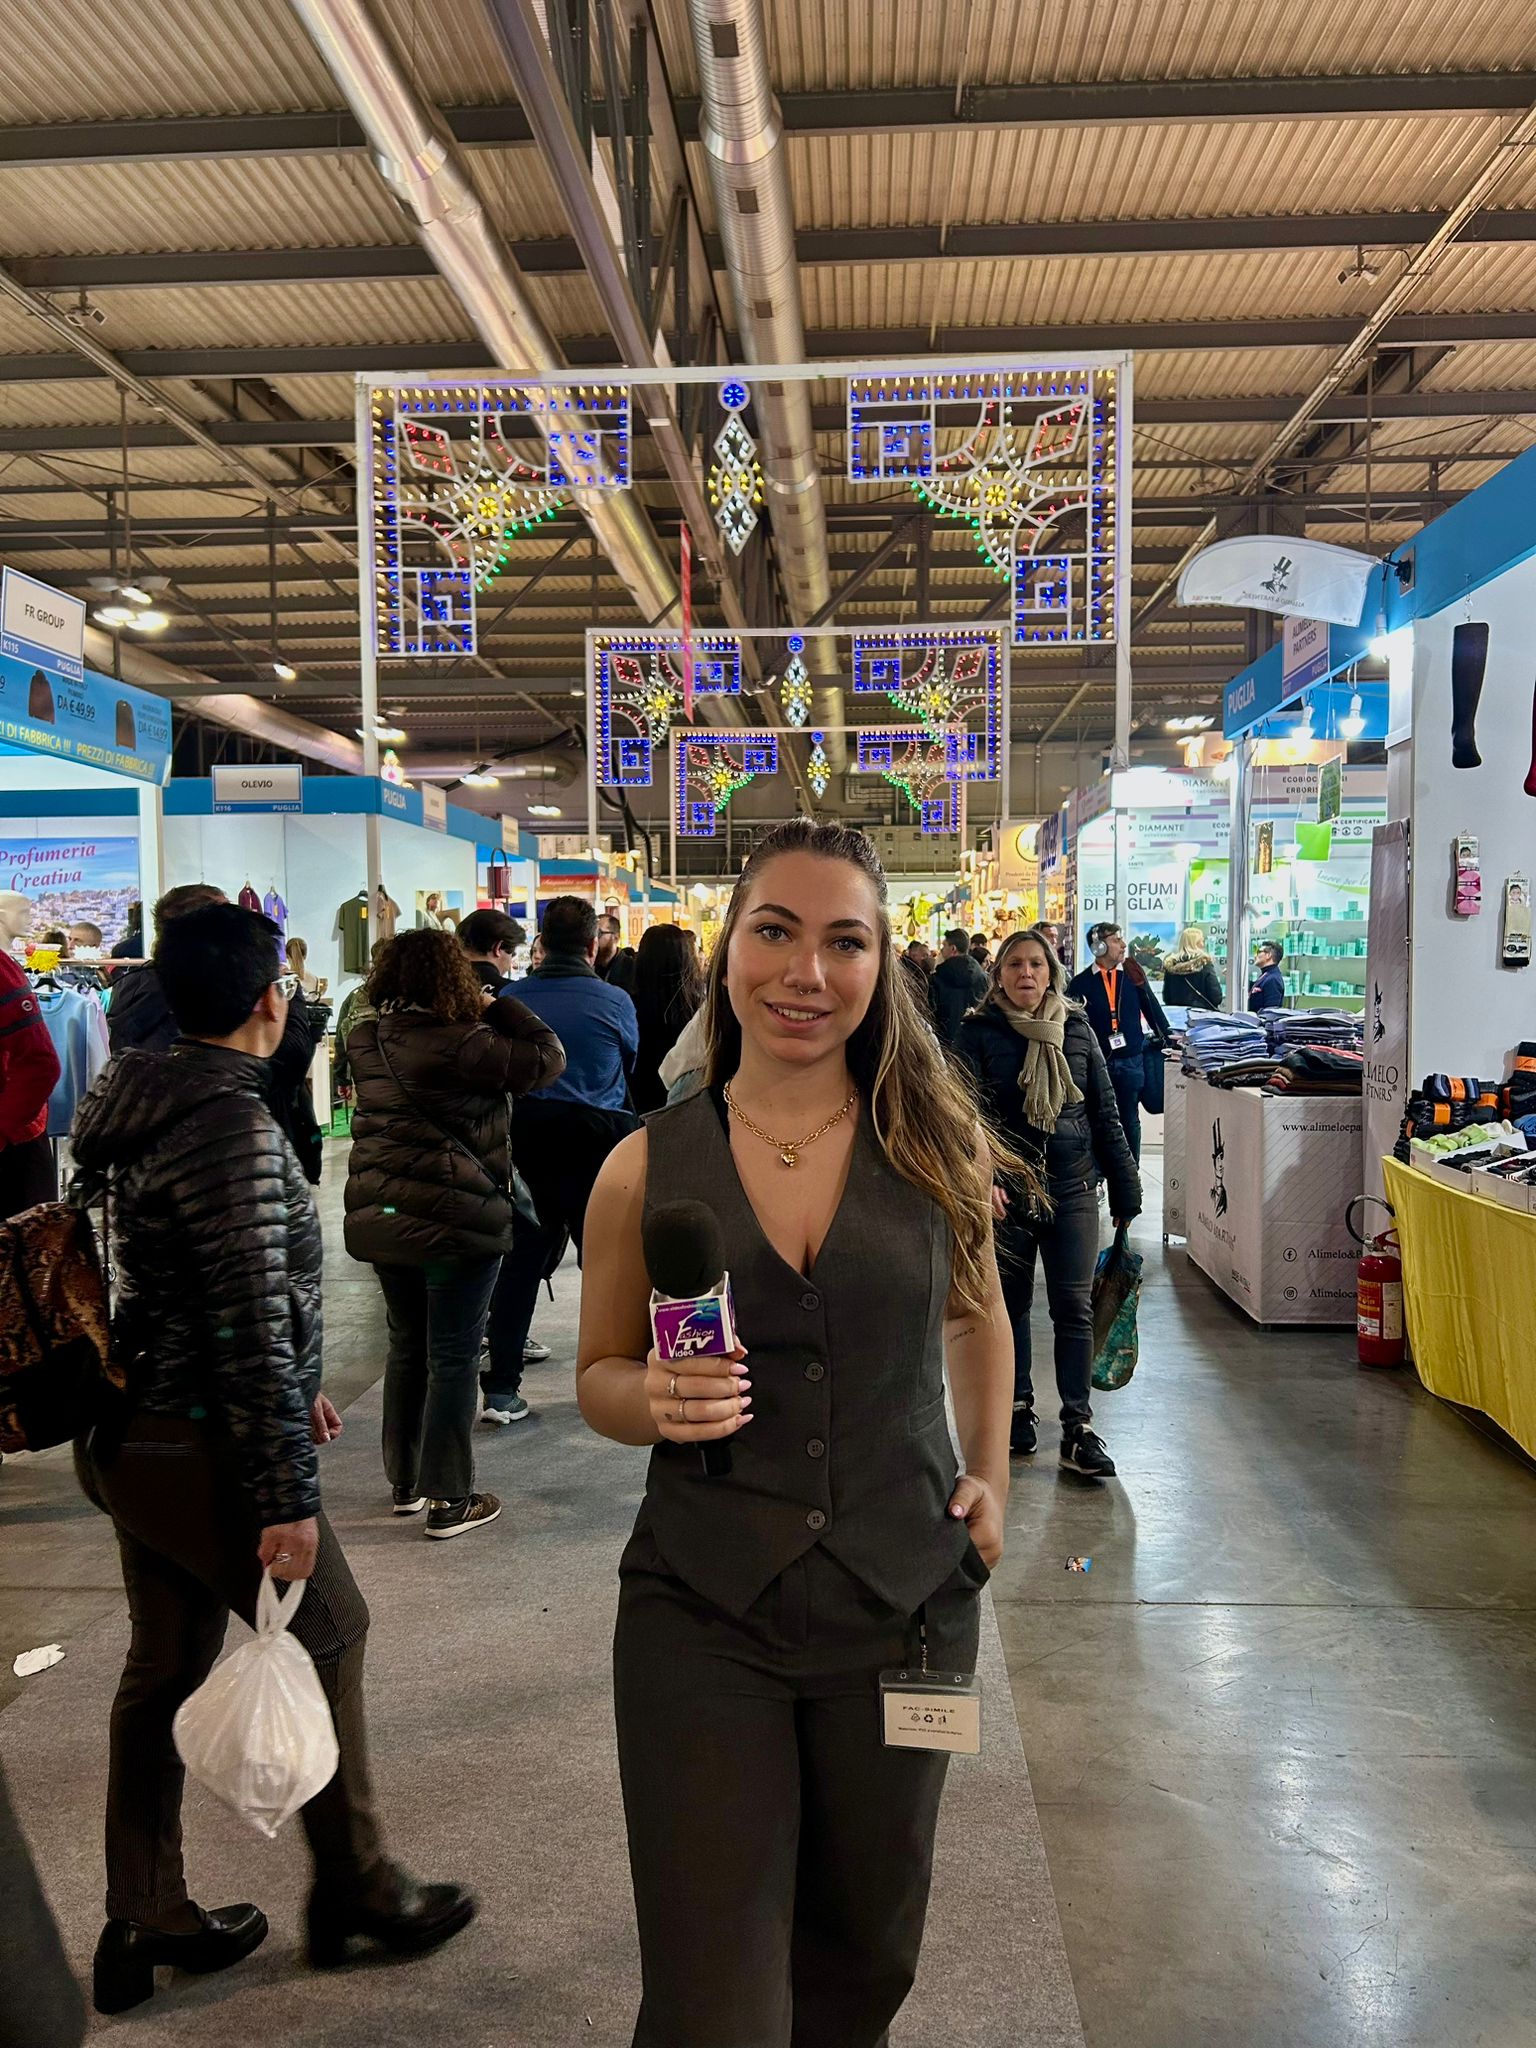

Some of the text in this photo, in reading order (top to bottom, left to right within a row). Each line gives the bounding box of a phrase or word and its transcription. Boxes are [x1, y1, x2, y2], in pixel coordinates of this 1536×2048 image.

[24, 603, 65, 630] FR GROUP
[3, 639, 19, 654] K115
[1292, 628, 1317, 655] PARTNERS
[57, 659, 81, 676] PUGLIA
[57, 695, 68, 711] DA
[1228, 678, 1255, 718] PUGLIA
[7, 723, 17, 739] DI
[19, 726, 62, 750] FABBRICA
[77, 742, 104, 762] PREZZI
[241, 780, 273, 789] OLEVIO
[1182, 779, 1229, 788] DIAMANT
[1282, 775, 1348, 783] ECOBIOCSI
[383, 787, 407, 810] PUGLIA
[1138, 823, 1185, 832] DIAMANTE
[0, 841, 97, 870] Profumeria
[10, 868, 82, 893] Creativa
[1105, 883, 1178, 896] POFUMI
[1084, 898, 1164, 911] DI PGLIA
[1282, 1122, 1363, 1134] www.alimeloepa
[1308, 1249, 1363, 1260] Alimelo&P
[664, 1329, 695, 1358] Video
[902, 1706, 955, 1714] FAC-SIMILE
